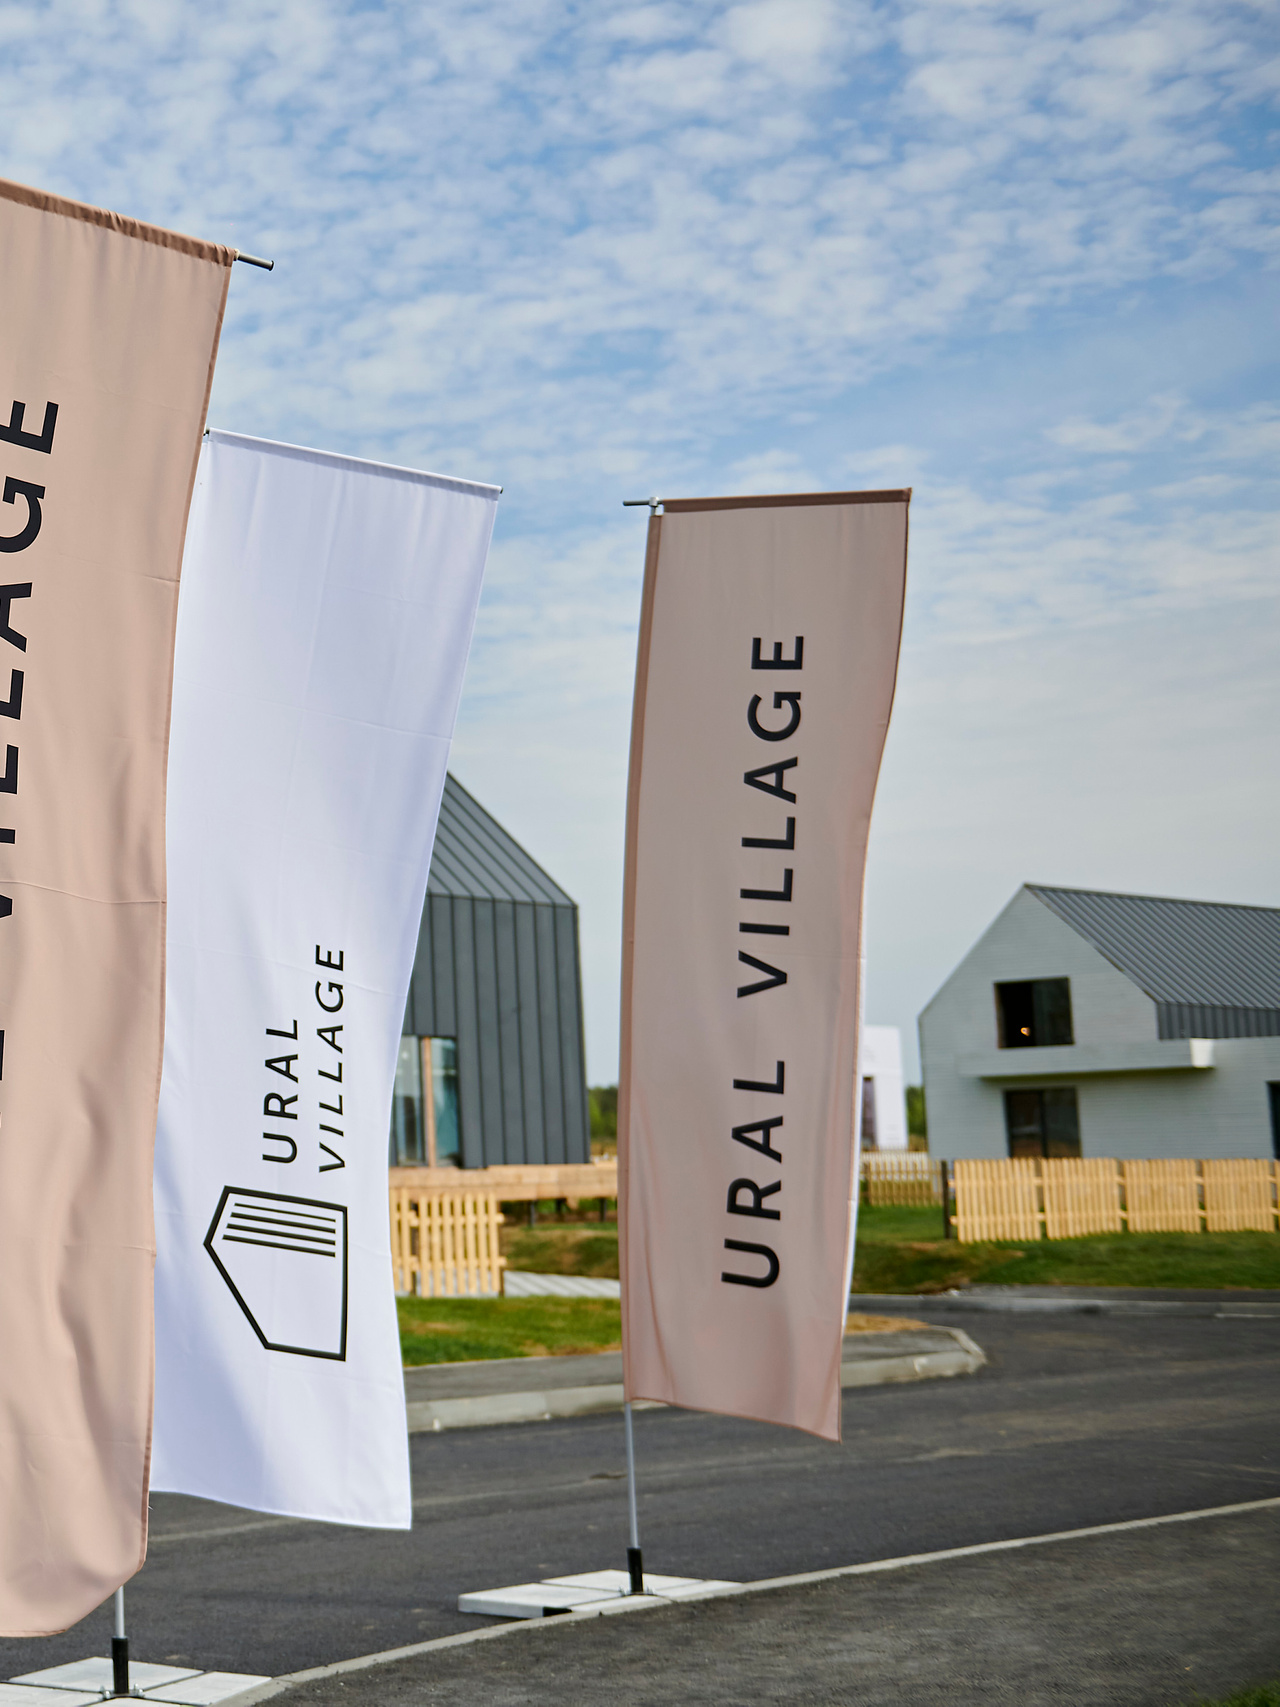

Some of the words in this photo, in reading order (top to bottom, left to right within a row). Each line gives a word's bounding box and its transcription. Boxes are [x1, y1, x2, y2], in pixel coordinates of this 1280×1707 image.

[735, 634, 806, 1000] VILLAGE
[261, 1018, 300, 1165] URAL
[314, 943, 347, 1174] VILLAGE
[719, 1059, 786, 1290] URAL
